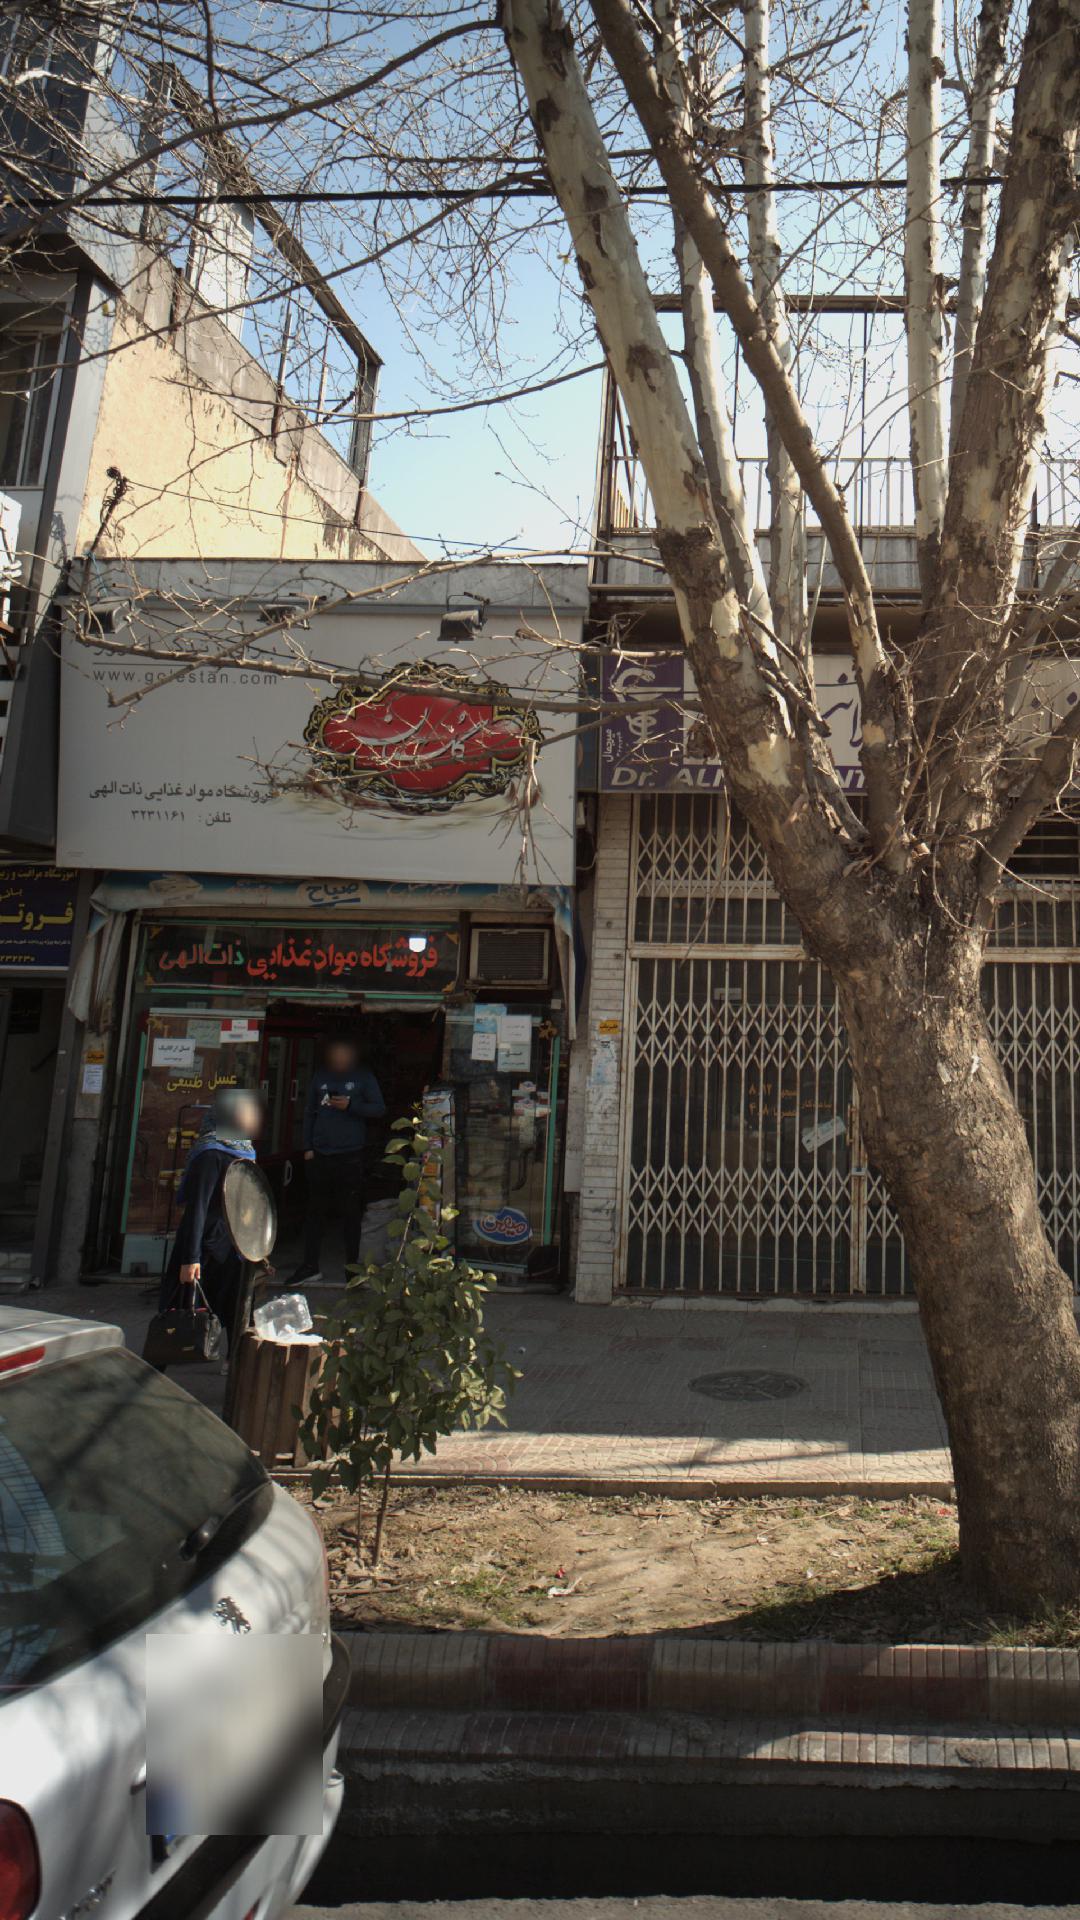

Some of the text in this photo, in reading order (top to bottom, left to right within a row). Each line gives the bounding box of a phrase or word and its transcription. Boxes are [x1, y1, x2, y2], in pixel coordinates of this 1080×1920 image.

[611, 767, 655, 787] Dr.
[89, 780, 117, 799] الهی
[119, 781, 142, 796] ذات
[144, 781, 182, 801] غذایی
[185, 783, 213, 801] مواد
[131, 809, 185, 822] ۳۲۳۱۱۶۱
[158, 935, 439, 980] فروشگاه مواد غذایی ذات الهی
[166, 1071, 238, 1094] عسل طبیعی
